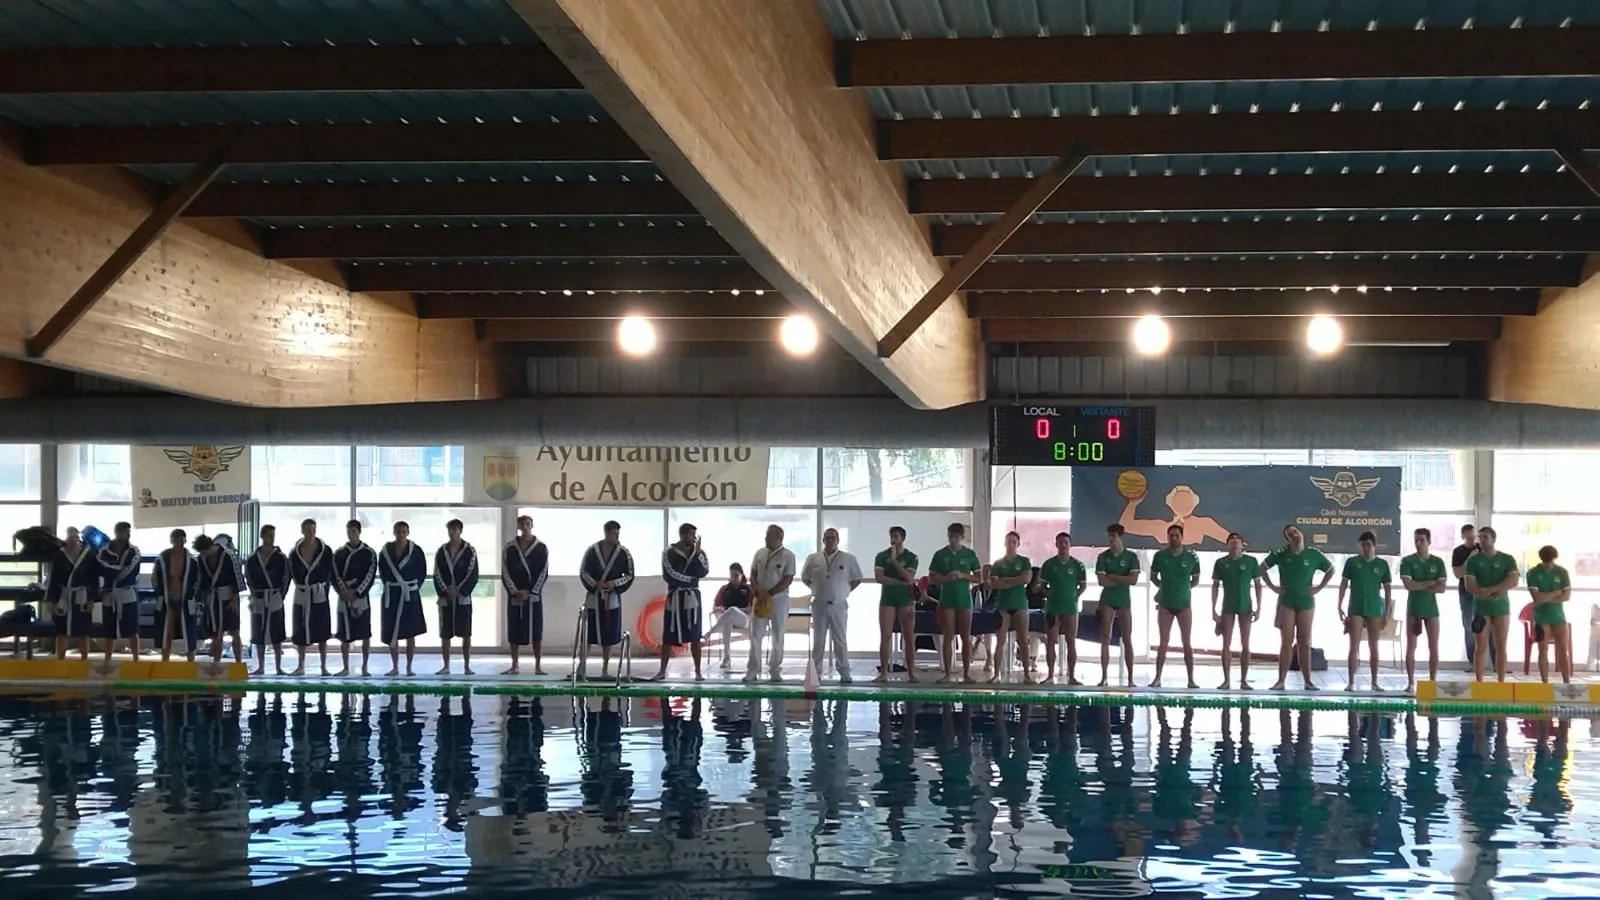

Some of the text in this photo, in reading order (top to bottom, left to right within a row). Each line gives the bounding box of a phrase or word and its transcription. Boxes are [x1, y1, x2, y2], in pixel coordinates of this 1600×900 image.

[1023, 407, 1129, 416] LOCAL VISITANTE
[1036, 418, 1050, 439] 0
[1107, 418, 1121, 439] 0
[1054, 442, 1103, 461] 8:00
[194, 483, 215, 492] CNCA
[550, 472, 737, 502] de Alcorcón
[160, 495, 207, 507] WATERPOLO
[1296, 517, 1330, 525] CIUDAD
[1345, 516, 1393, 526] ALCORCÓN
